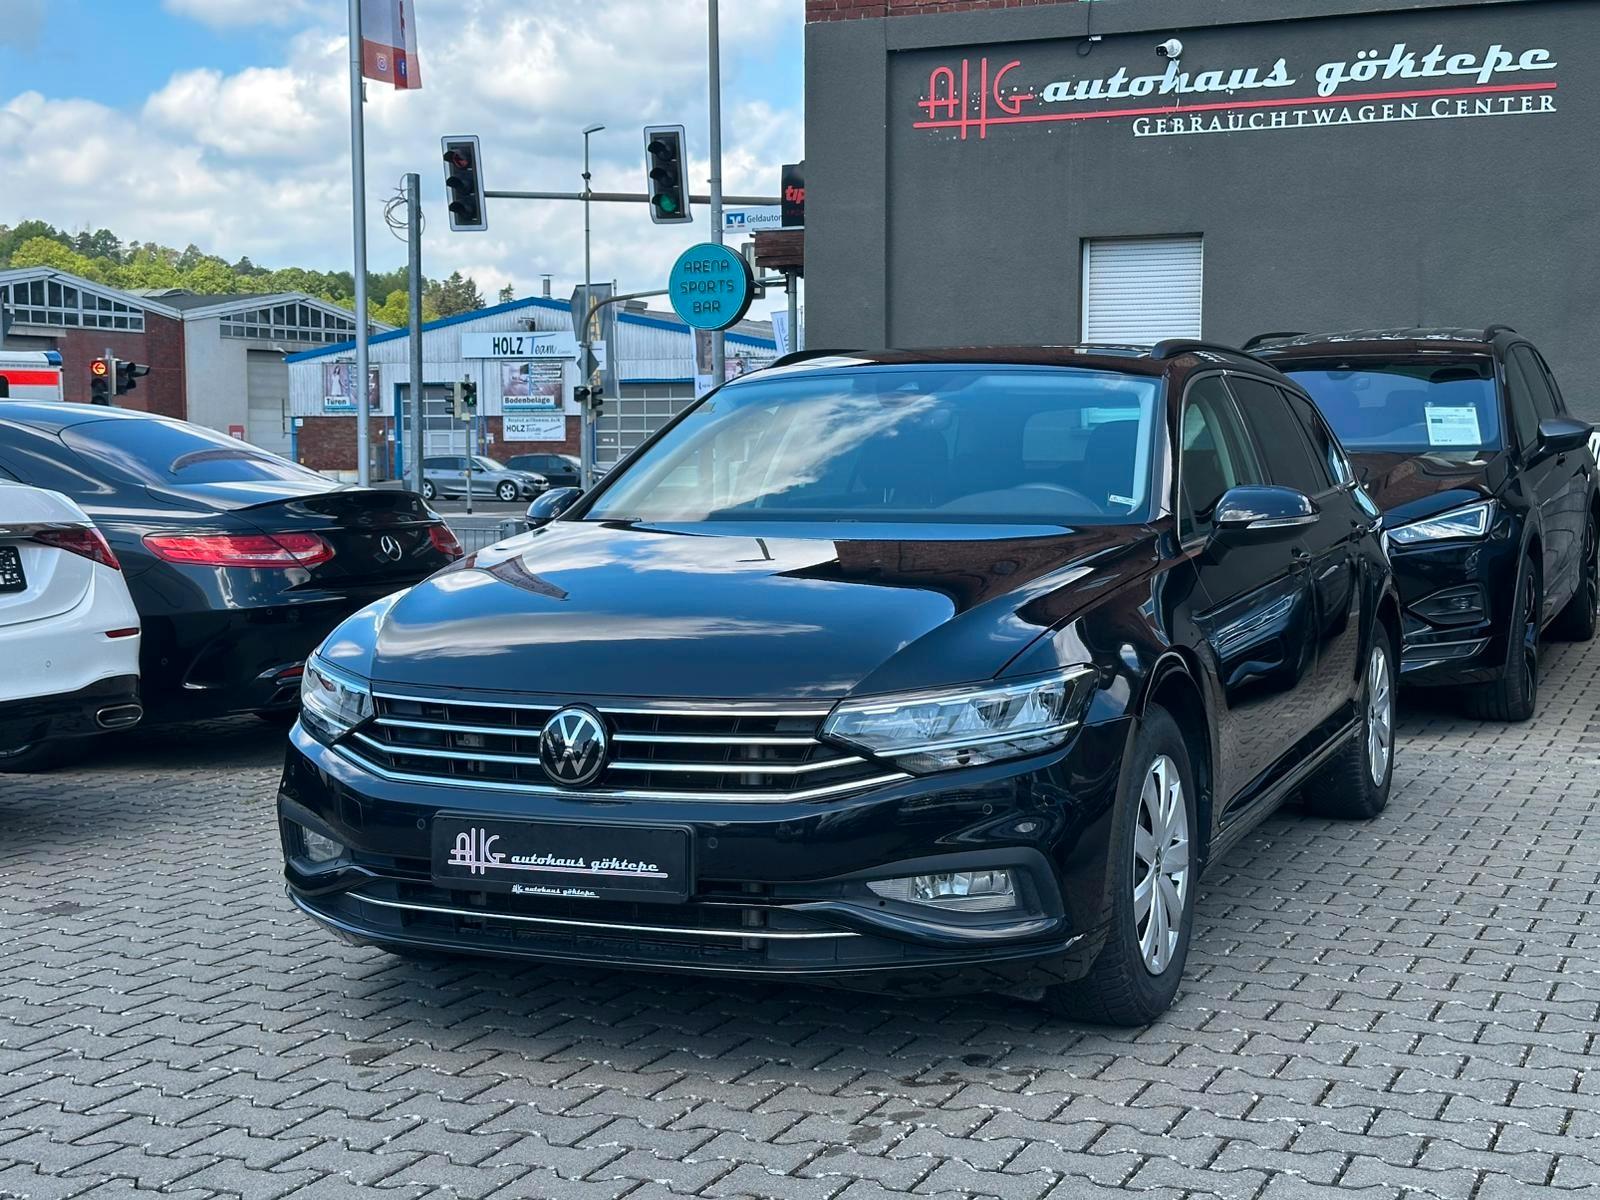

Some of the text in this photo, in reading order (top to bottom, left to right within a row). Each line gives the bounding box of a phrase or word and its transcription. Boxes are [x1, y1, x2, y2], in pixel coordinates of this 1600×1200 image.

[916, 43, 1558, 140] AHG autohaus göktepe
[1132, 95, 1557, 136] GEBRAUCHTWAGEN CENTER
[684, 259, 729, 273] ARENA
[680, 279, 734, 294] SPORTS
[693, 300, 721, 313] BAR
[492, 333, 558, 355] HOLZ Team
[506, 424, 526, 433] HOLZ
[450, 828, 660, 875] AHG autohaus göktepe
[524, 885, 561, 894] autohaus
[562, 888, 596, 897] göktepe
